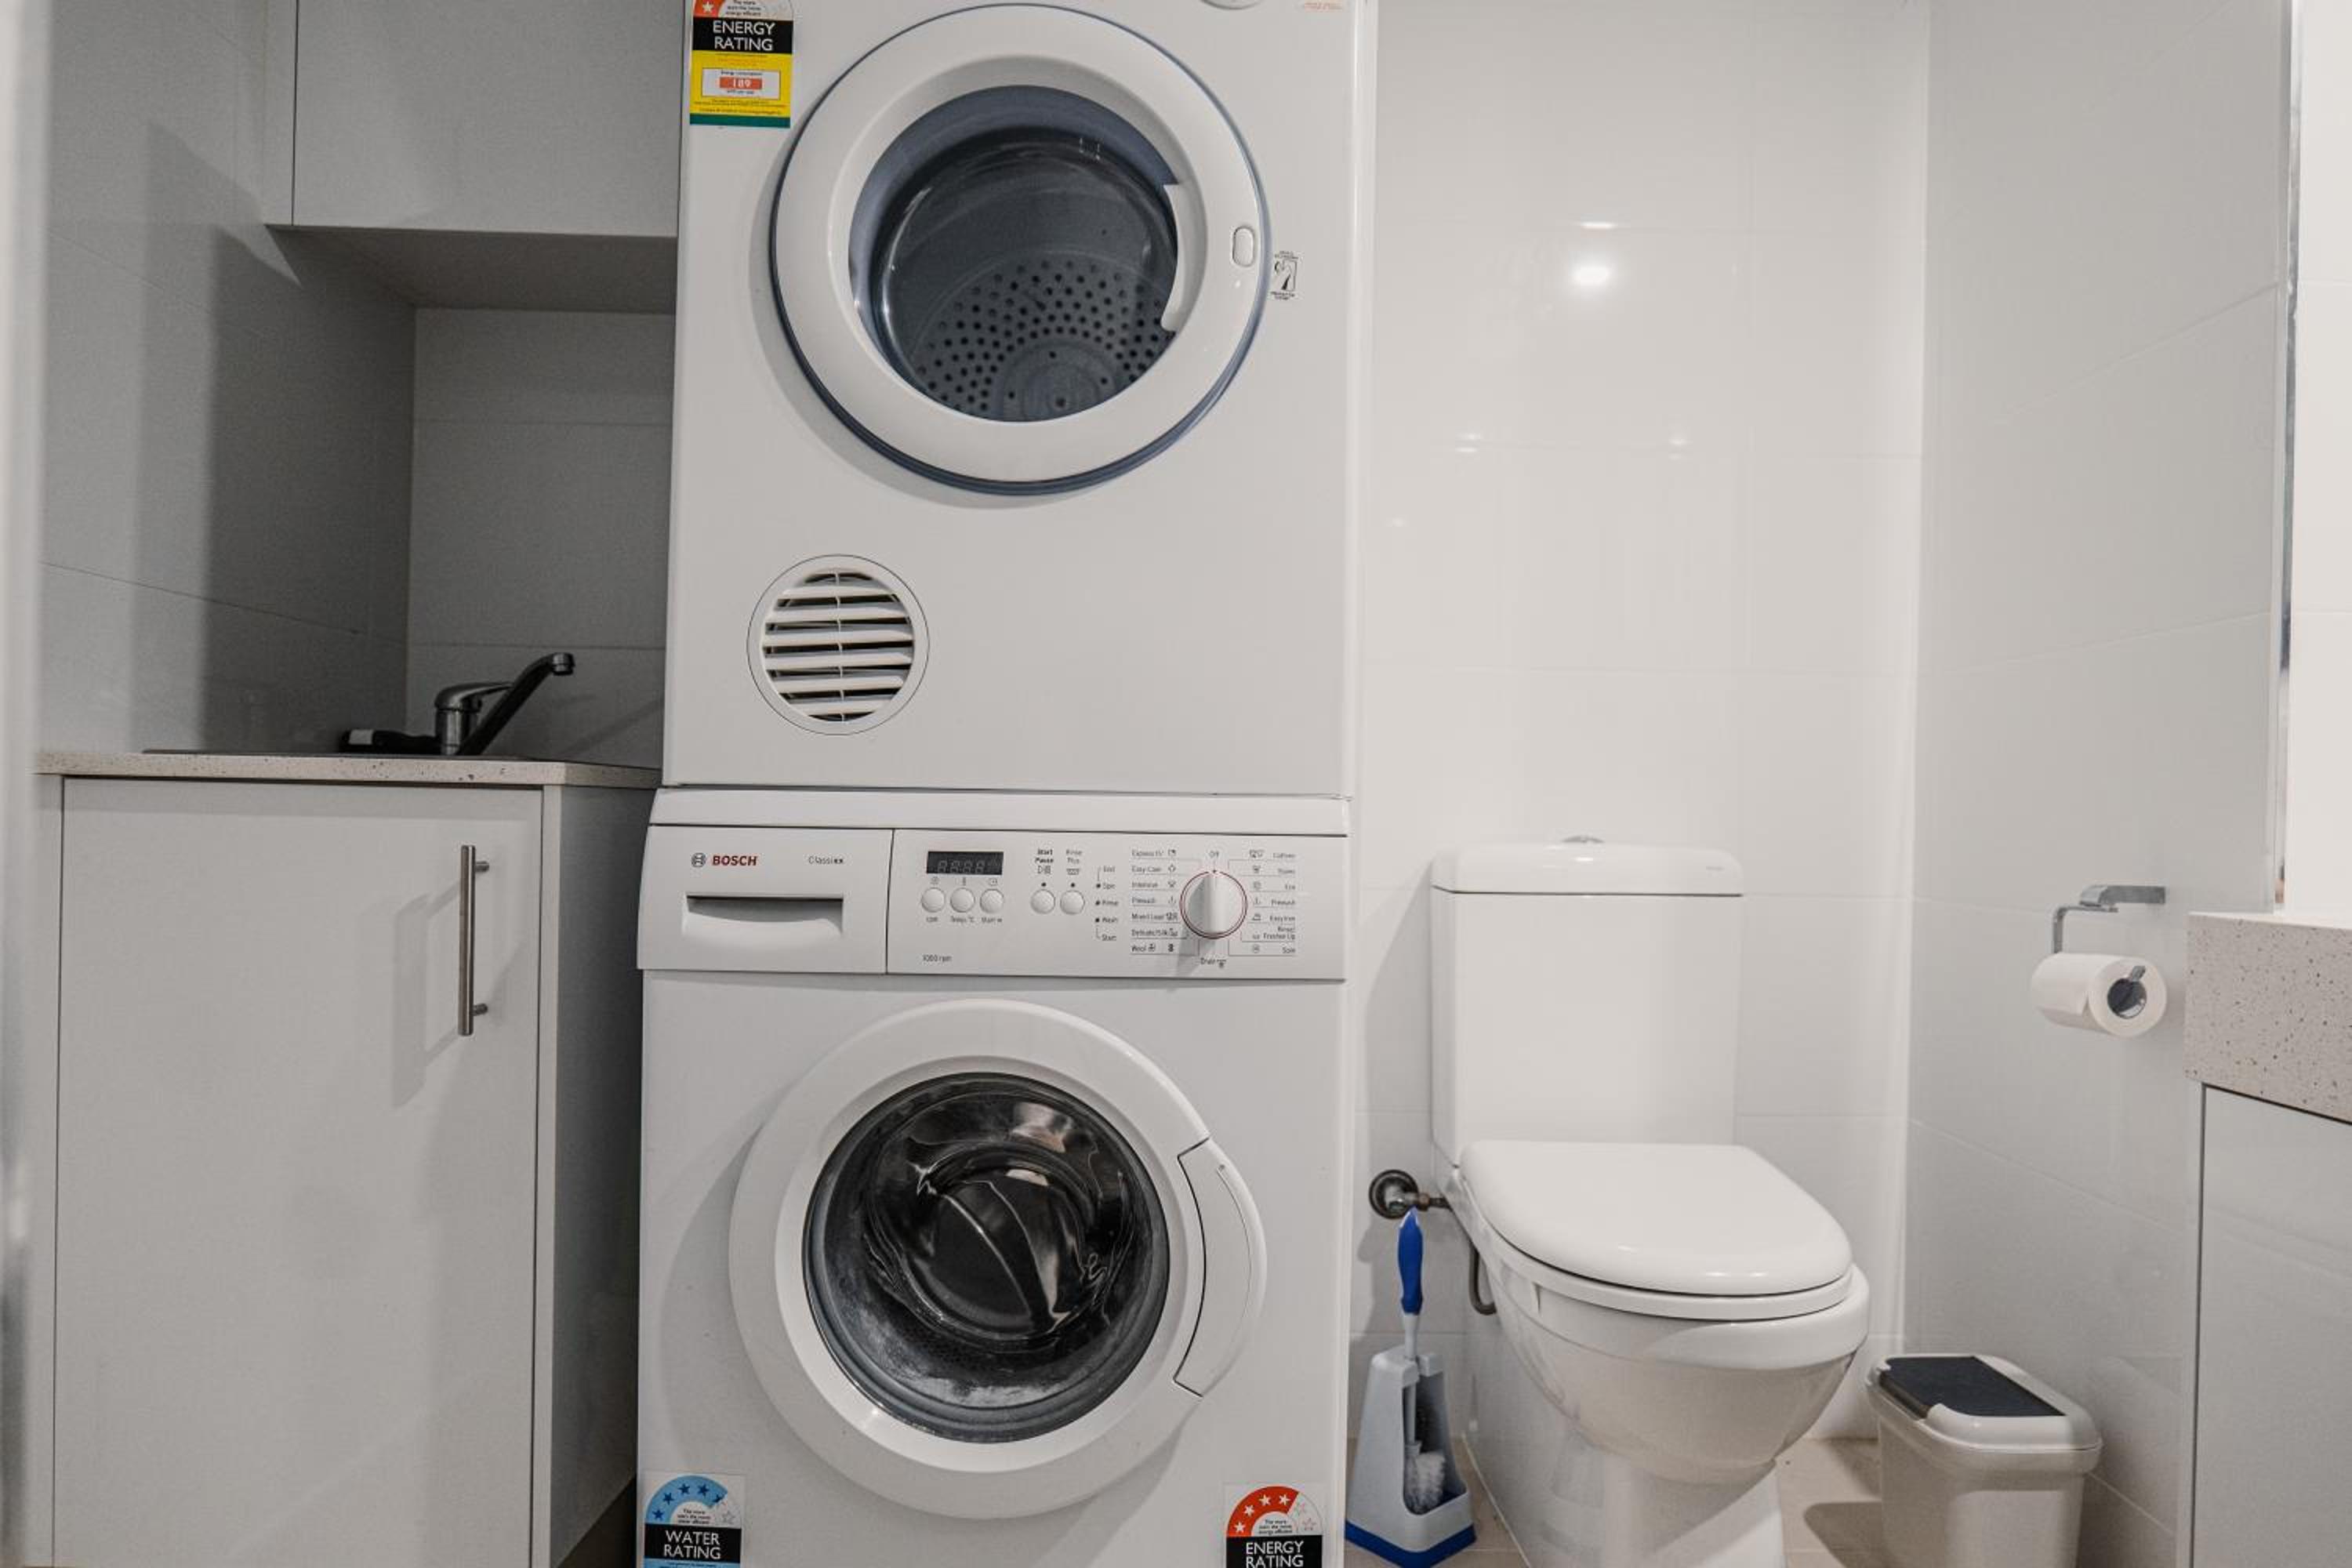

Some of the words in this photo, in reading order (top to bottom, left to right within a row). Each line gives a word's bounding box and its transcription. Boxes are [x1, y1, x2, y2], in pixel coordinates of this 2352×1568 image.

[713, 20, 775, 35] ENERGY
[714, 37, 773, 51] RATING
[712, 855, 757, 866] BOSCH
[665, 1530, 720, 1545] WATER
[663, 1544, 721, 1559] RATING
[1245, 1540, 1305, 1555] ENERGY
[1245, 1554, 1305, 1568] RATING
